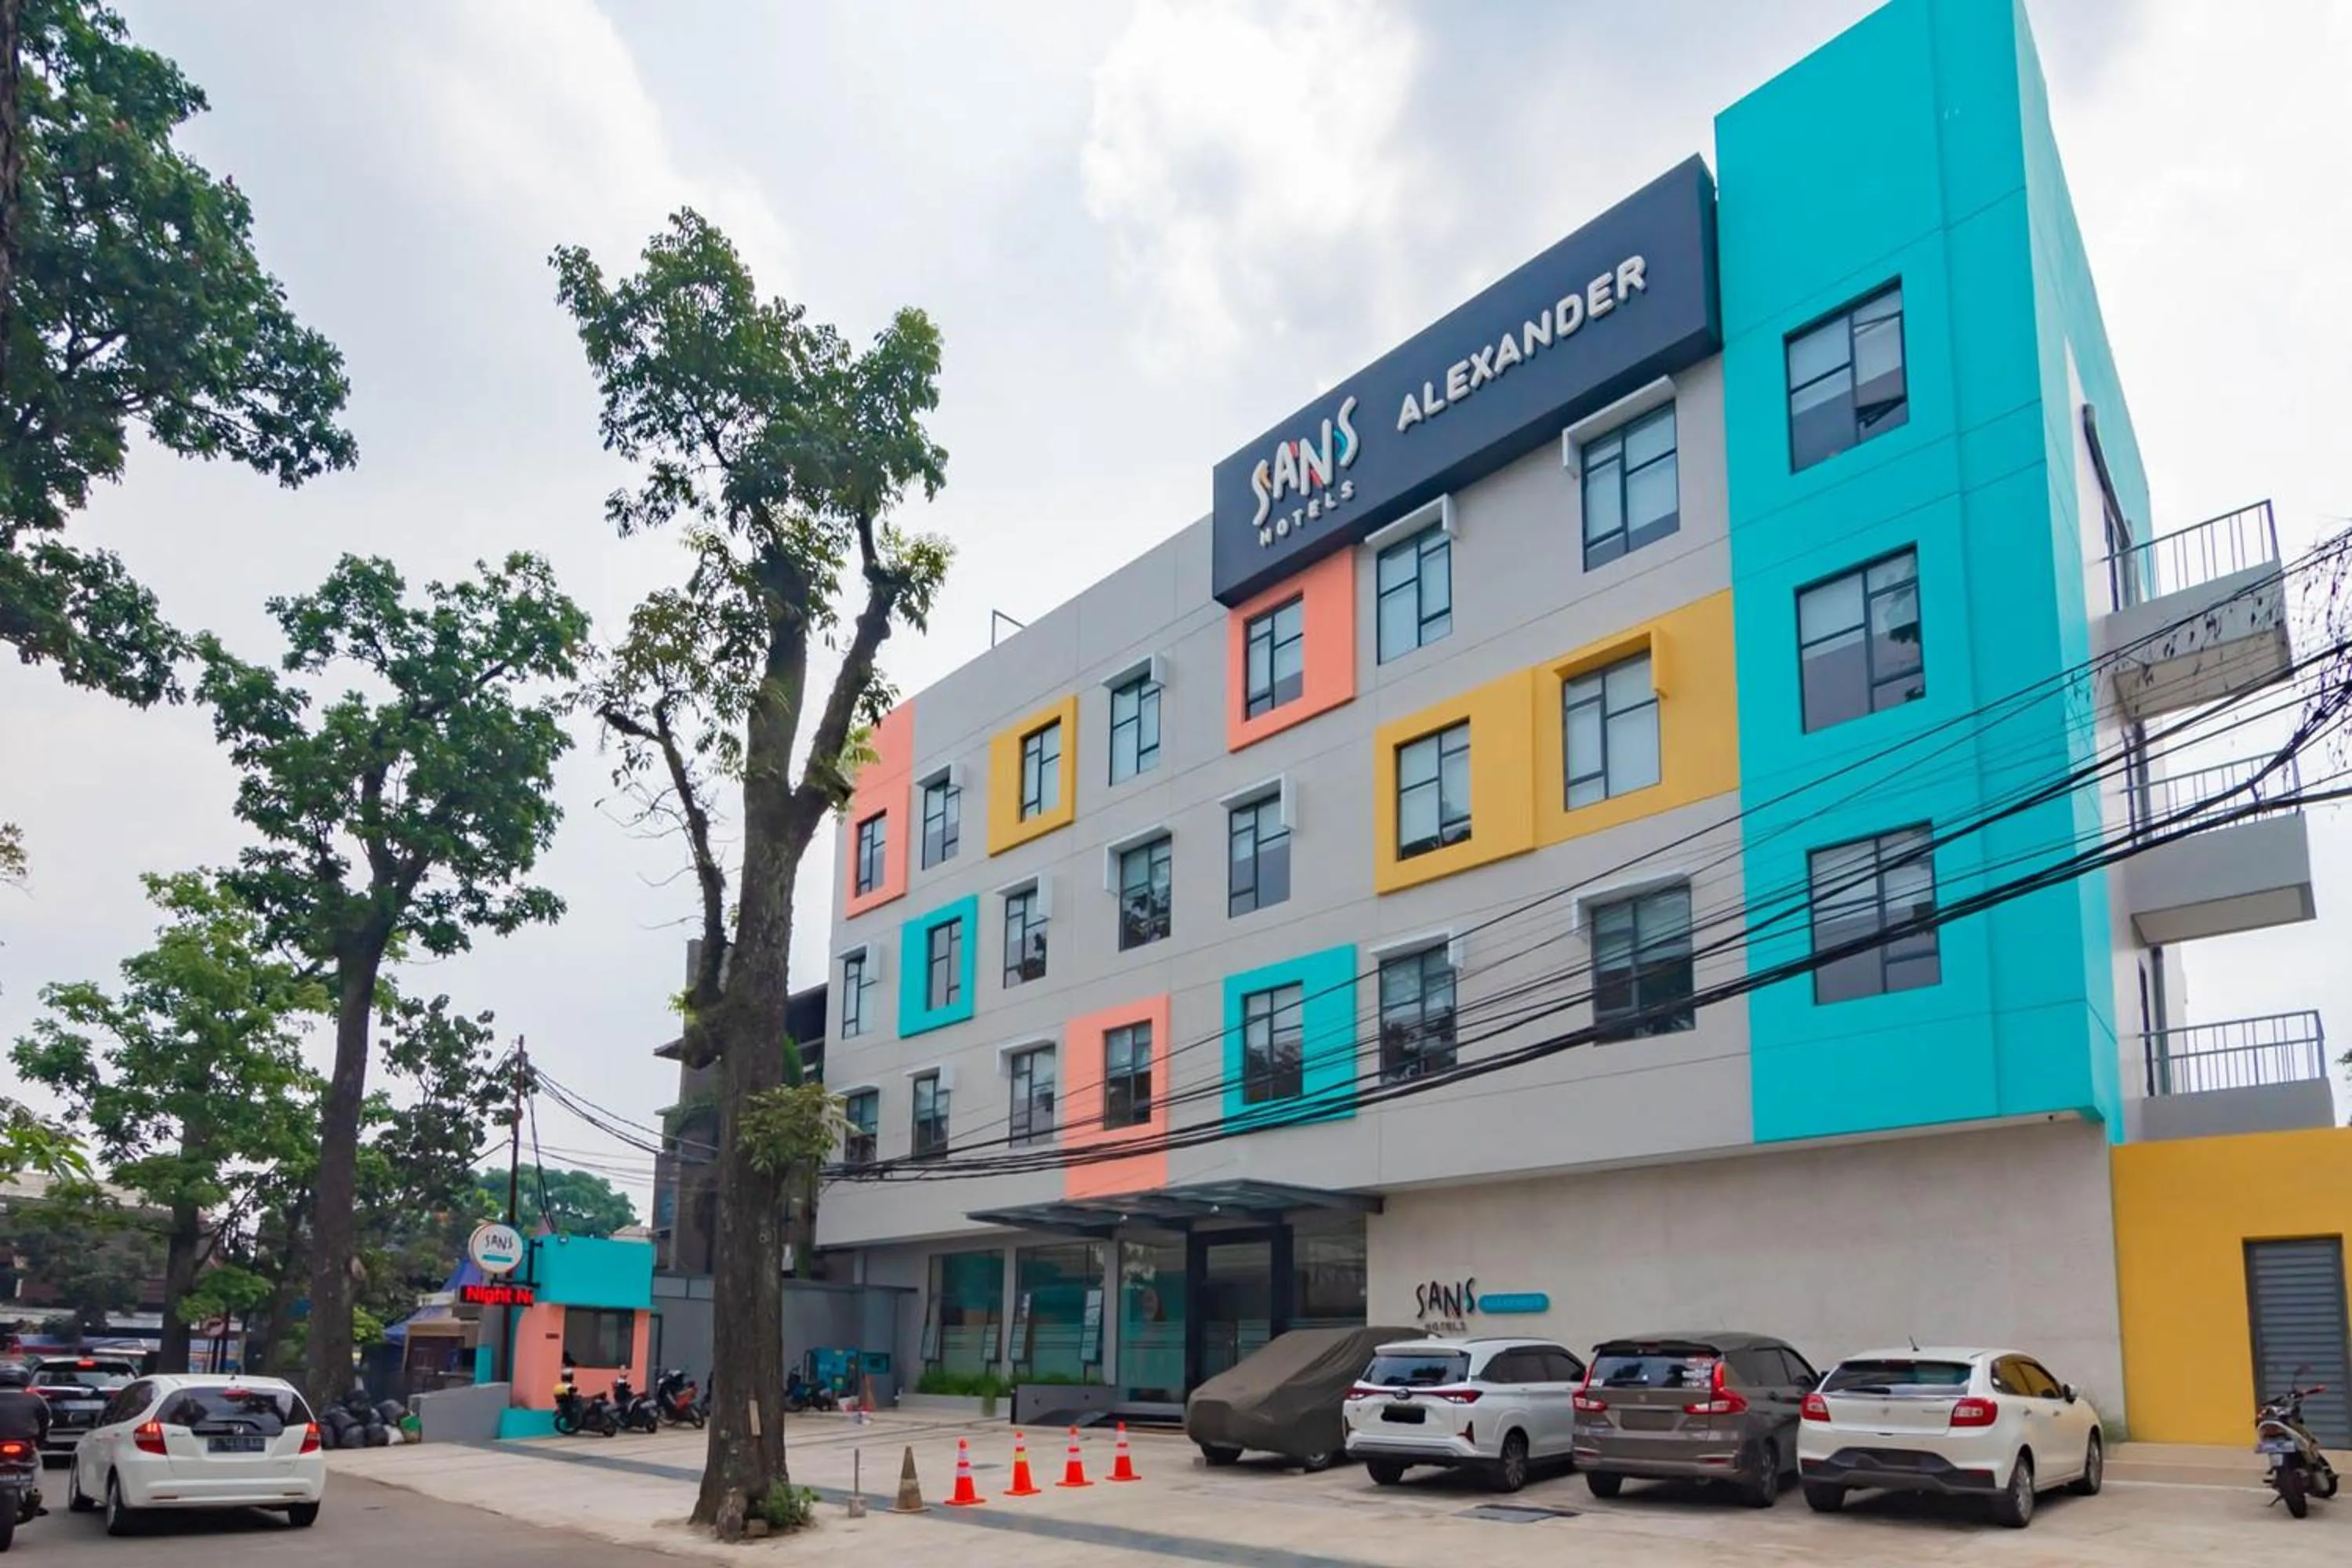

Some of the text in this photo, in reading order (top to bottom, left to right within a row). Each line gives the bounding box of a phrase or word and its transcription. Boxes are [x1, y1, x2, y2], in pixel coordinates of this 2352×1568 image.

[1397, 255, 1646, 432] ALEXANDER
[1251, 395, 1359, 526] SANS
[1259, 479, 1355, 547] HOTELS
[484, 1234, 514, 1250] SANS
[466, 1286, 511, 1305] Night
[1415, 1276, 1475, 1319] SANS
